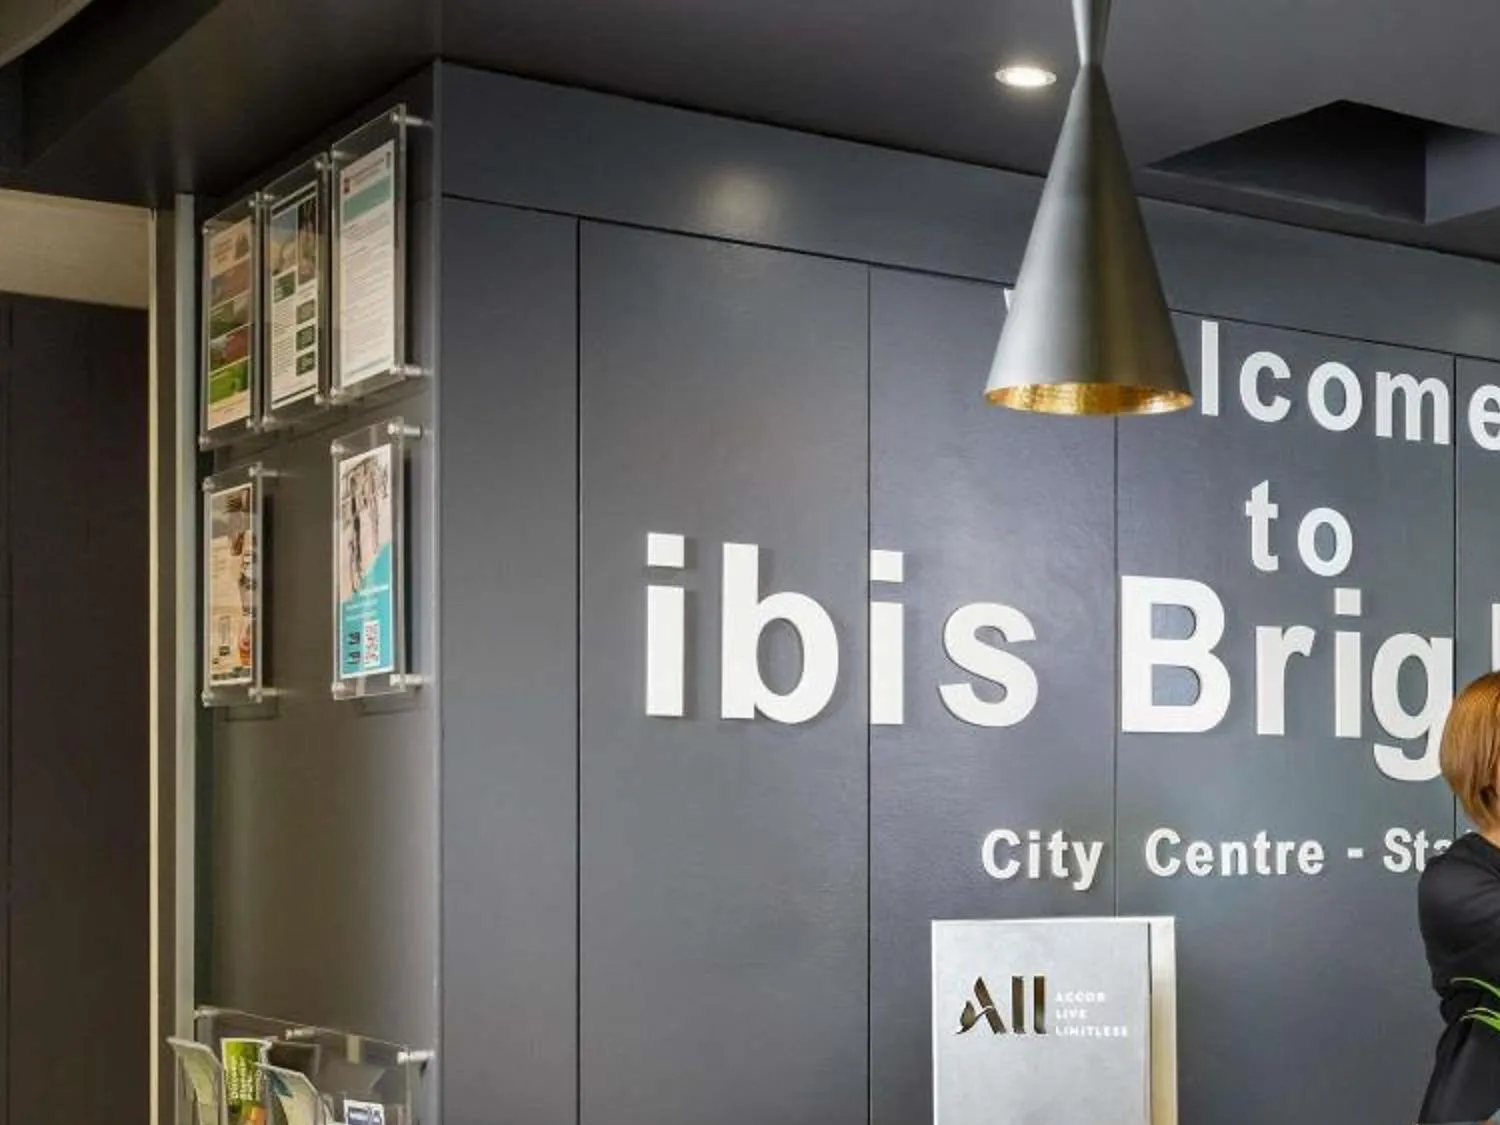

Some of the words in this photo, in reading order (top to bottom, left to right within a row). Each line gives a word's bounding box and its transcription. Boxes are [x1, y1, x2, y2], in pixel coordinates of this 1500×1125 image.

[1245, 478, 1353, 577] to
[645, 530, 1039, 727] ibis
[980, 827, 1104, 891] City
[1144, 826, 1325, 877] Centre
[1055, 1008, 1089, 1019] LIVE
[1055, 1025, 1129, 1038] LIMITLESS
